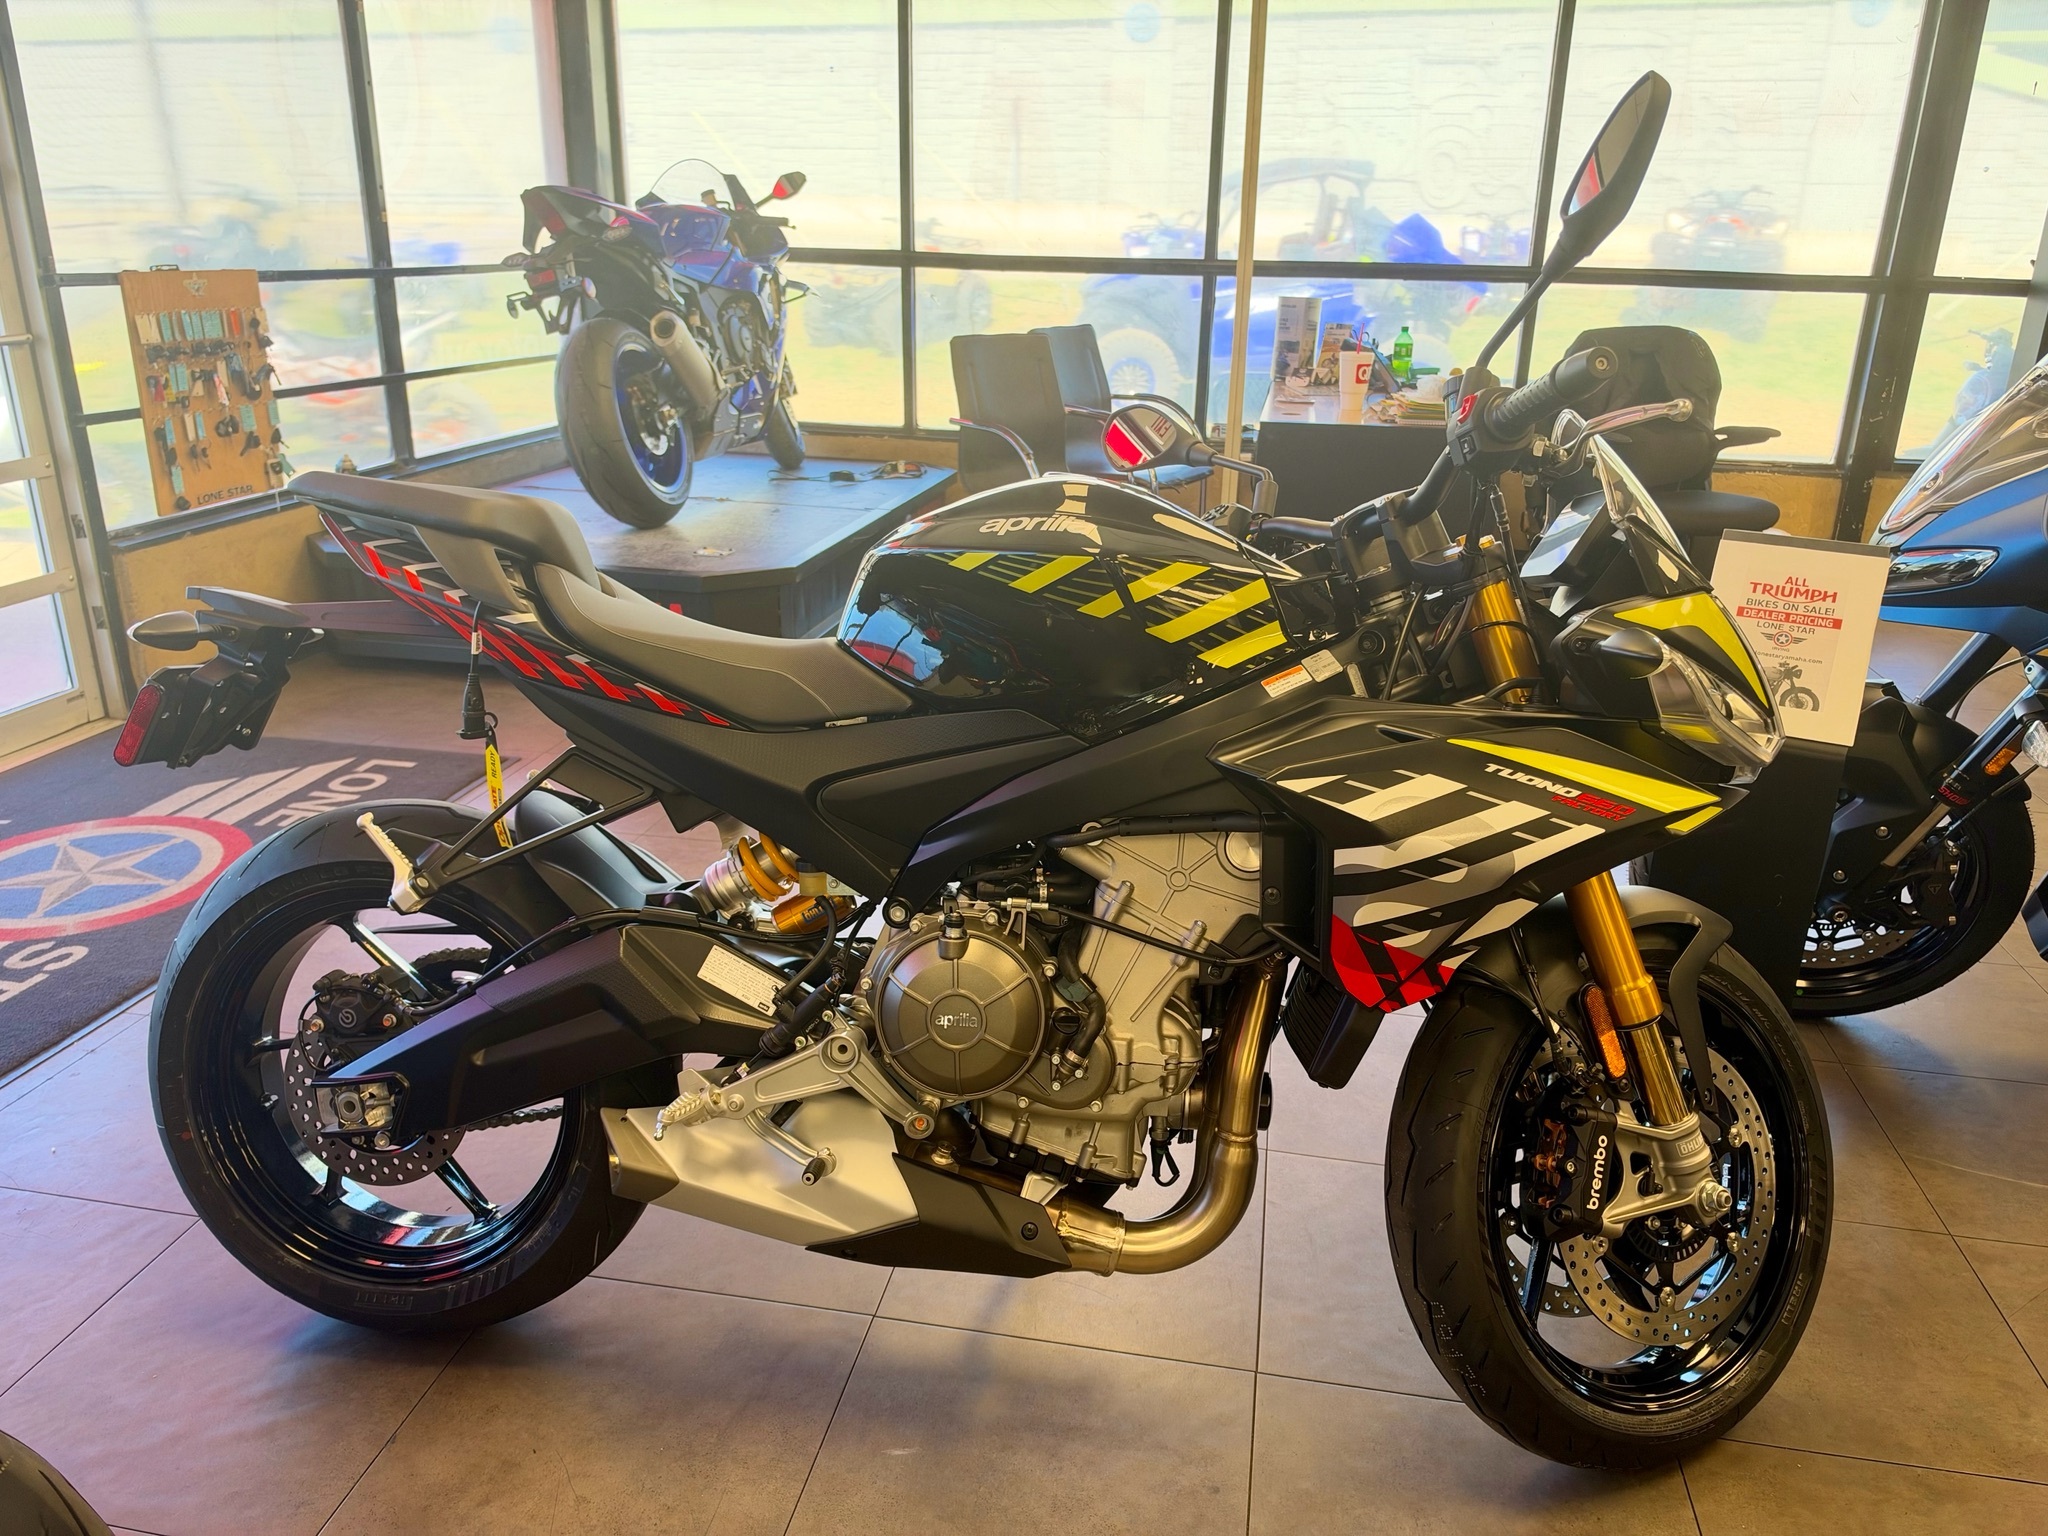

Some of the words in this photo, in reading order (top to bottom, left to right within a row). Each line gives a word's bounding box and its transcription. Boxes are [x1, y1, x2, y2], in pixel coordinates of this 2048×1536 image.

[197, 490, 224, 505] LONE
[227, 484, 254, 498] STAR
[979, 514, 1087, 536] aprilia
[1785, 576, 1809, 587] ALL
[1749, 582, 1838, 604] TRIUMPH
[1746, 598, 1779, 609] BIKES
[1782, 602, 1800, 612] ON
[1802, 605, 1835, 616] SALE!
[1743, 608, 1786, 621] DEALER
[1789, 614, 1834, 628] PRICING
[1756, 621, 1785, 631] LONE
[1788, 625, 1815, 635] STAR
[255, 759, 418, 827] LONE
[1484, 763, 1583, 798] TUONO
[1576, 793, 1637, 816] 660
[1551, 795, 1627, 822] FACTORY
[935, 1012, 978, 1029] aprilia
[1587, 1135, 1608, 1210] brembo
